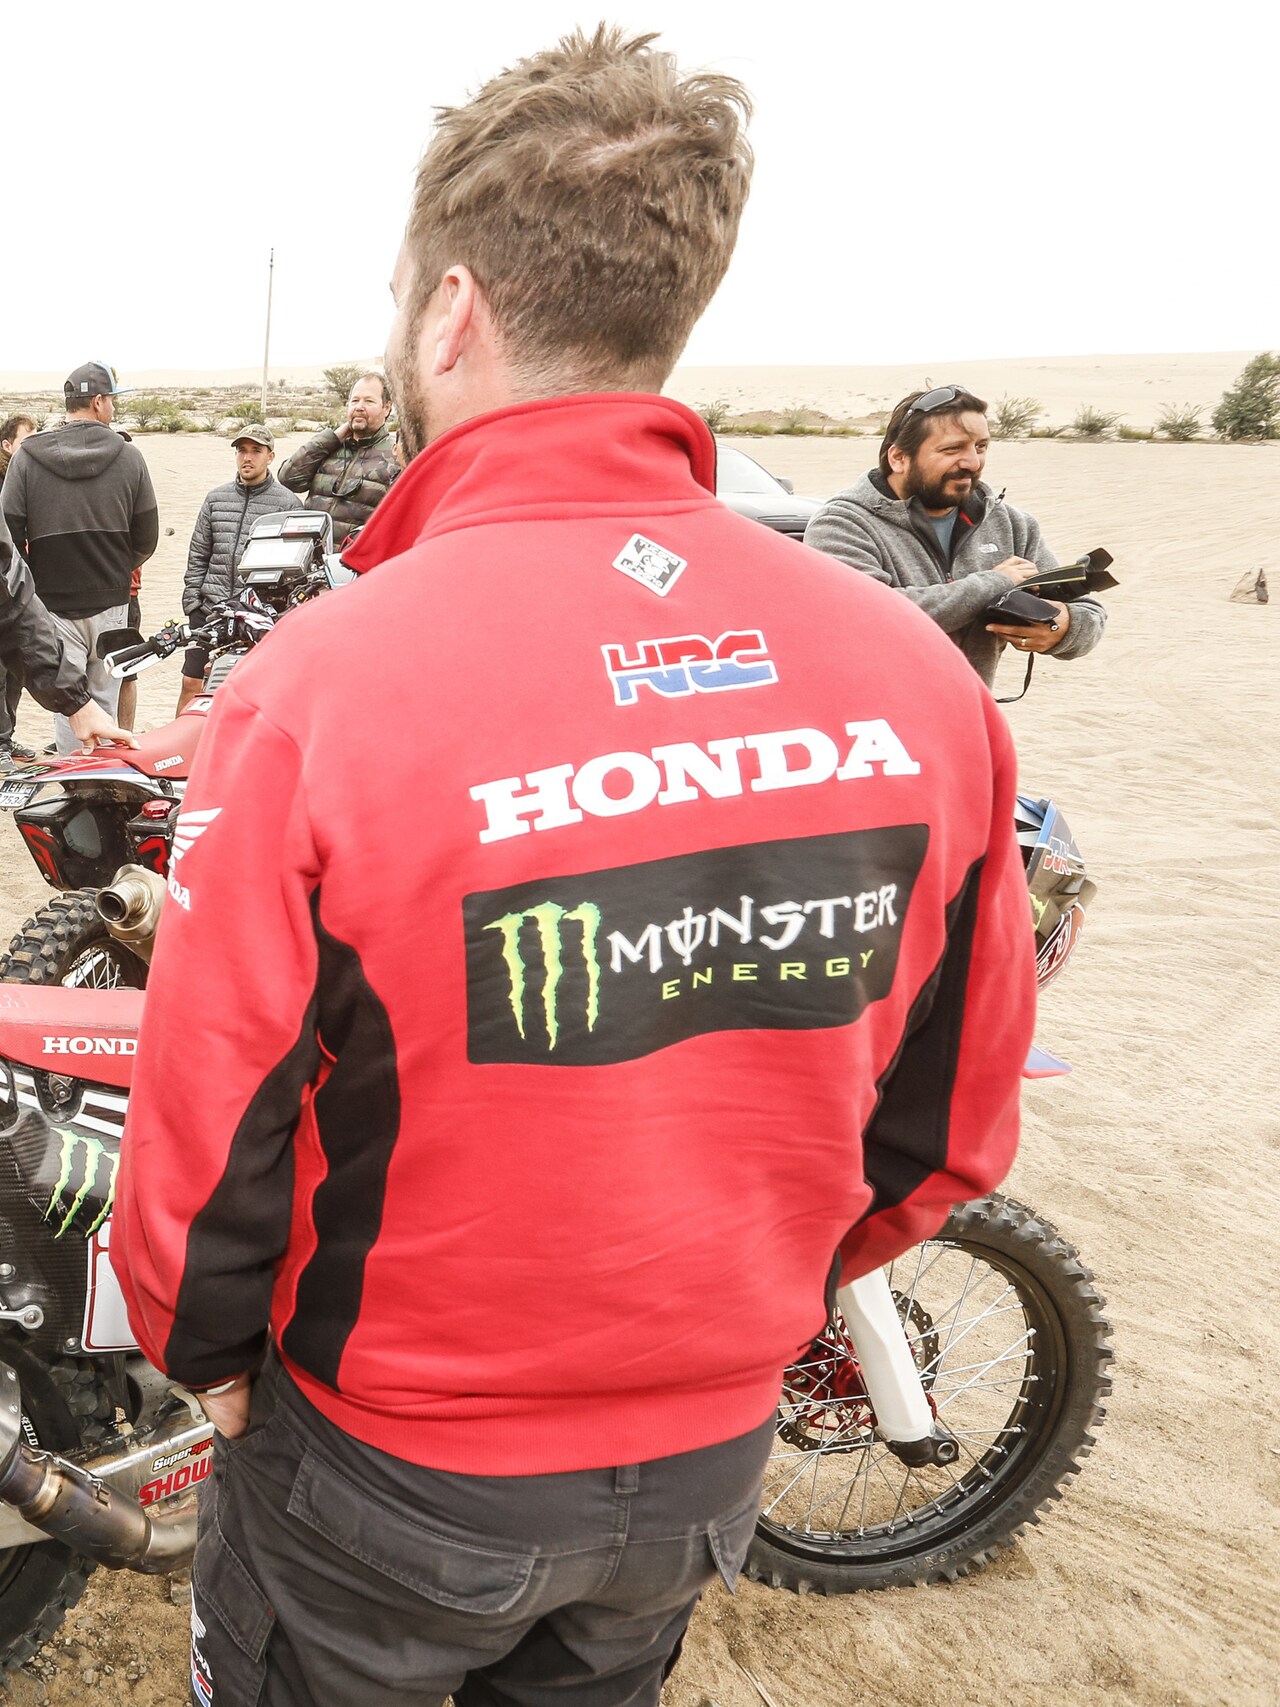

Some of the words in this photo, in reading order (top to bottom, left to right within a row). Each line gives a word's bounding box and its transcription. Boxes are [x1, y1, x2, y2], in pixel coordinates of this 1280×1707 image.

[601, 630, 779, 706] HRC
[469, 718, 921, 844] HONDA
[606, 883, 898, 974] MONSTER
[662, 949, 875, 1000] ENERGY
[41, 1036, 138, 1056] HOND
[139, 1456, 214, 1507] SHOW
